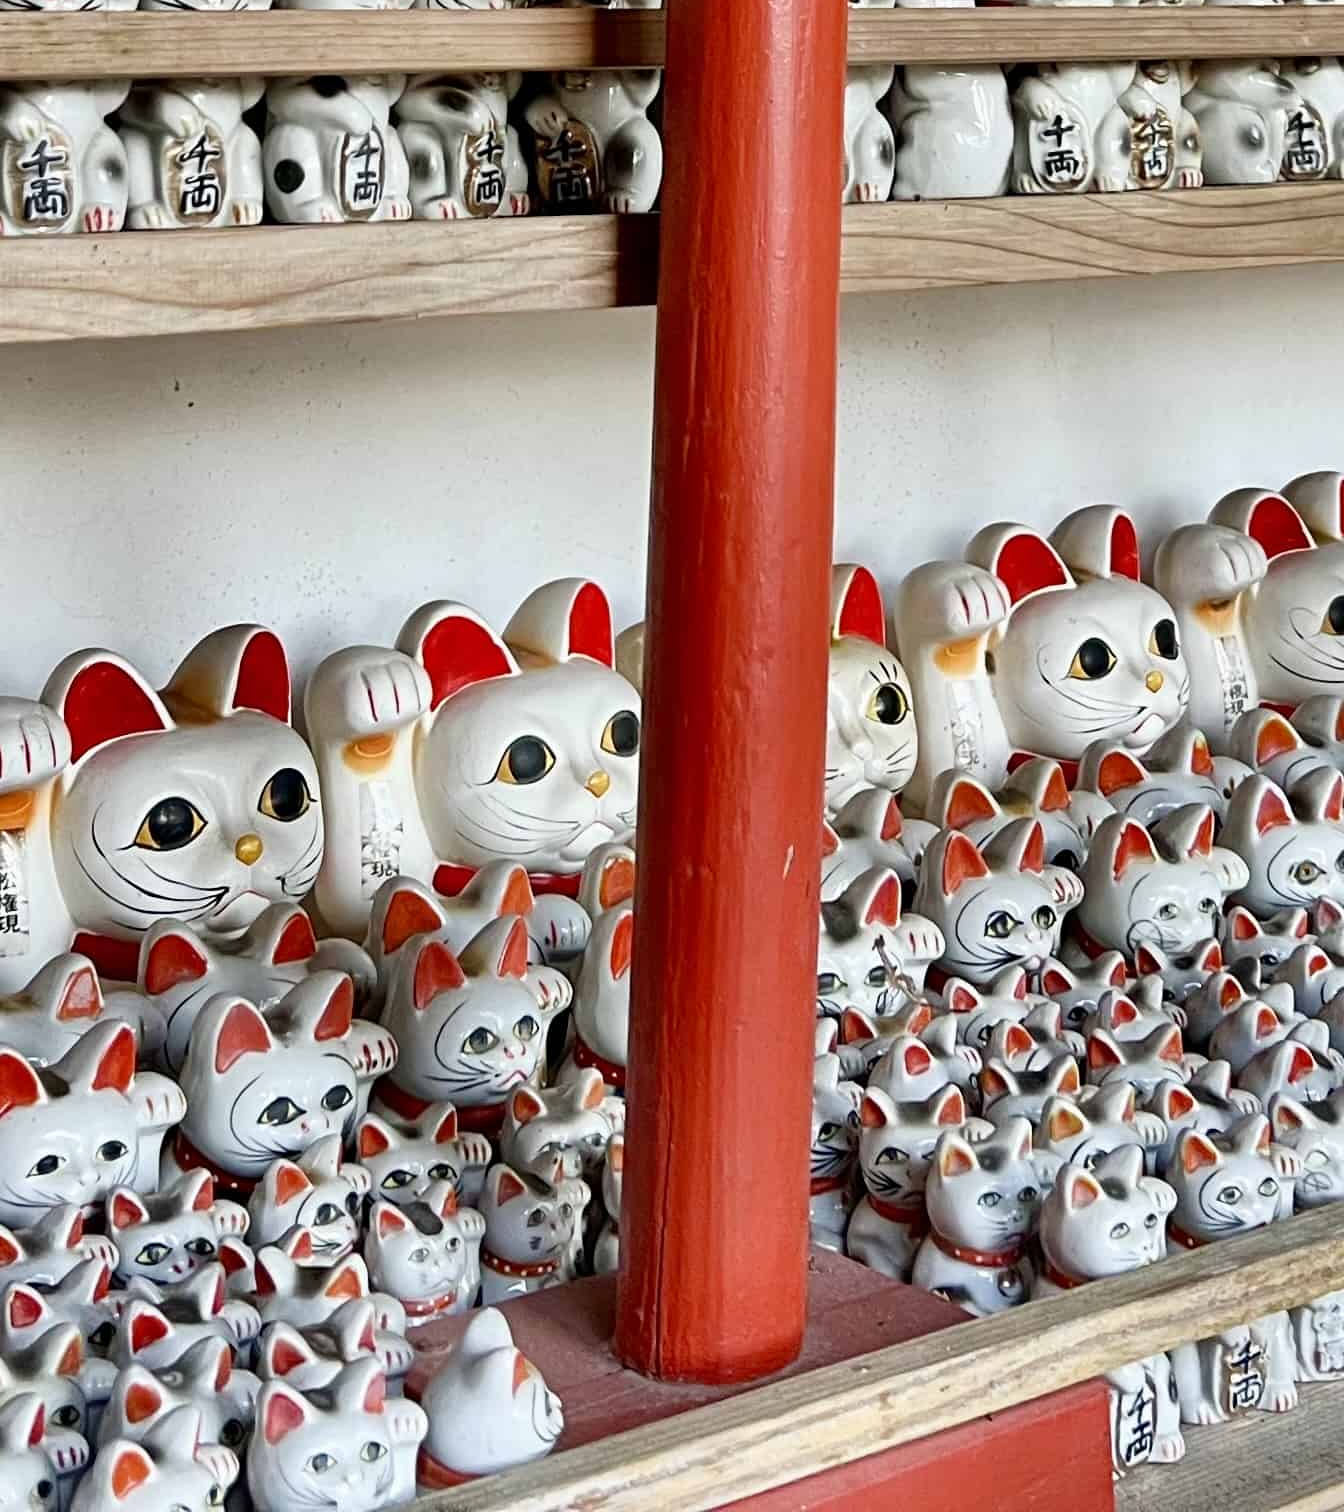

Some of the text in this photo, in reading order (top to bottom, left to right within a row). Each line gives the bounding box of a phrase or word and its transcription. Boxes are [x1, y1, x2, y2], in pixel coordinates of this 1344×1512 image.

[178, 134, 222, 215] 千両
[352, 133, 380, 204] 千両
[476, 132, 505, 203] 千両
[1287, 111, 1320, 169] 千両
[21, 140, 68, 220] 千両
[1230, 1341, 1264, 1410] 千両
[1126, 1388, 1154, 1463] 千両
